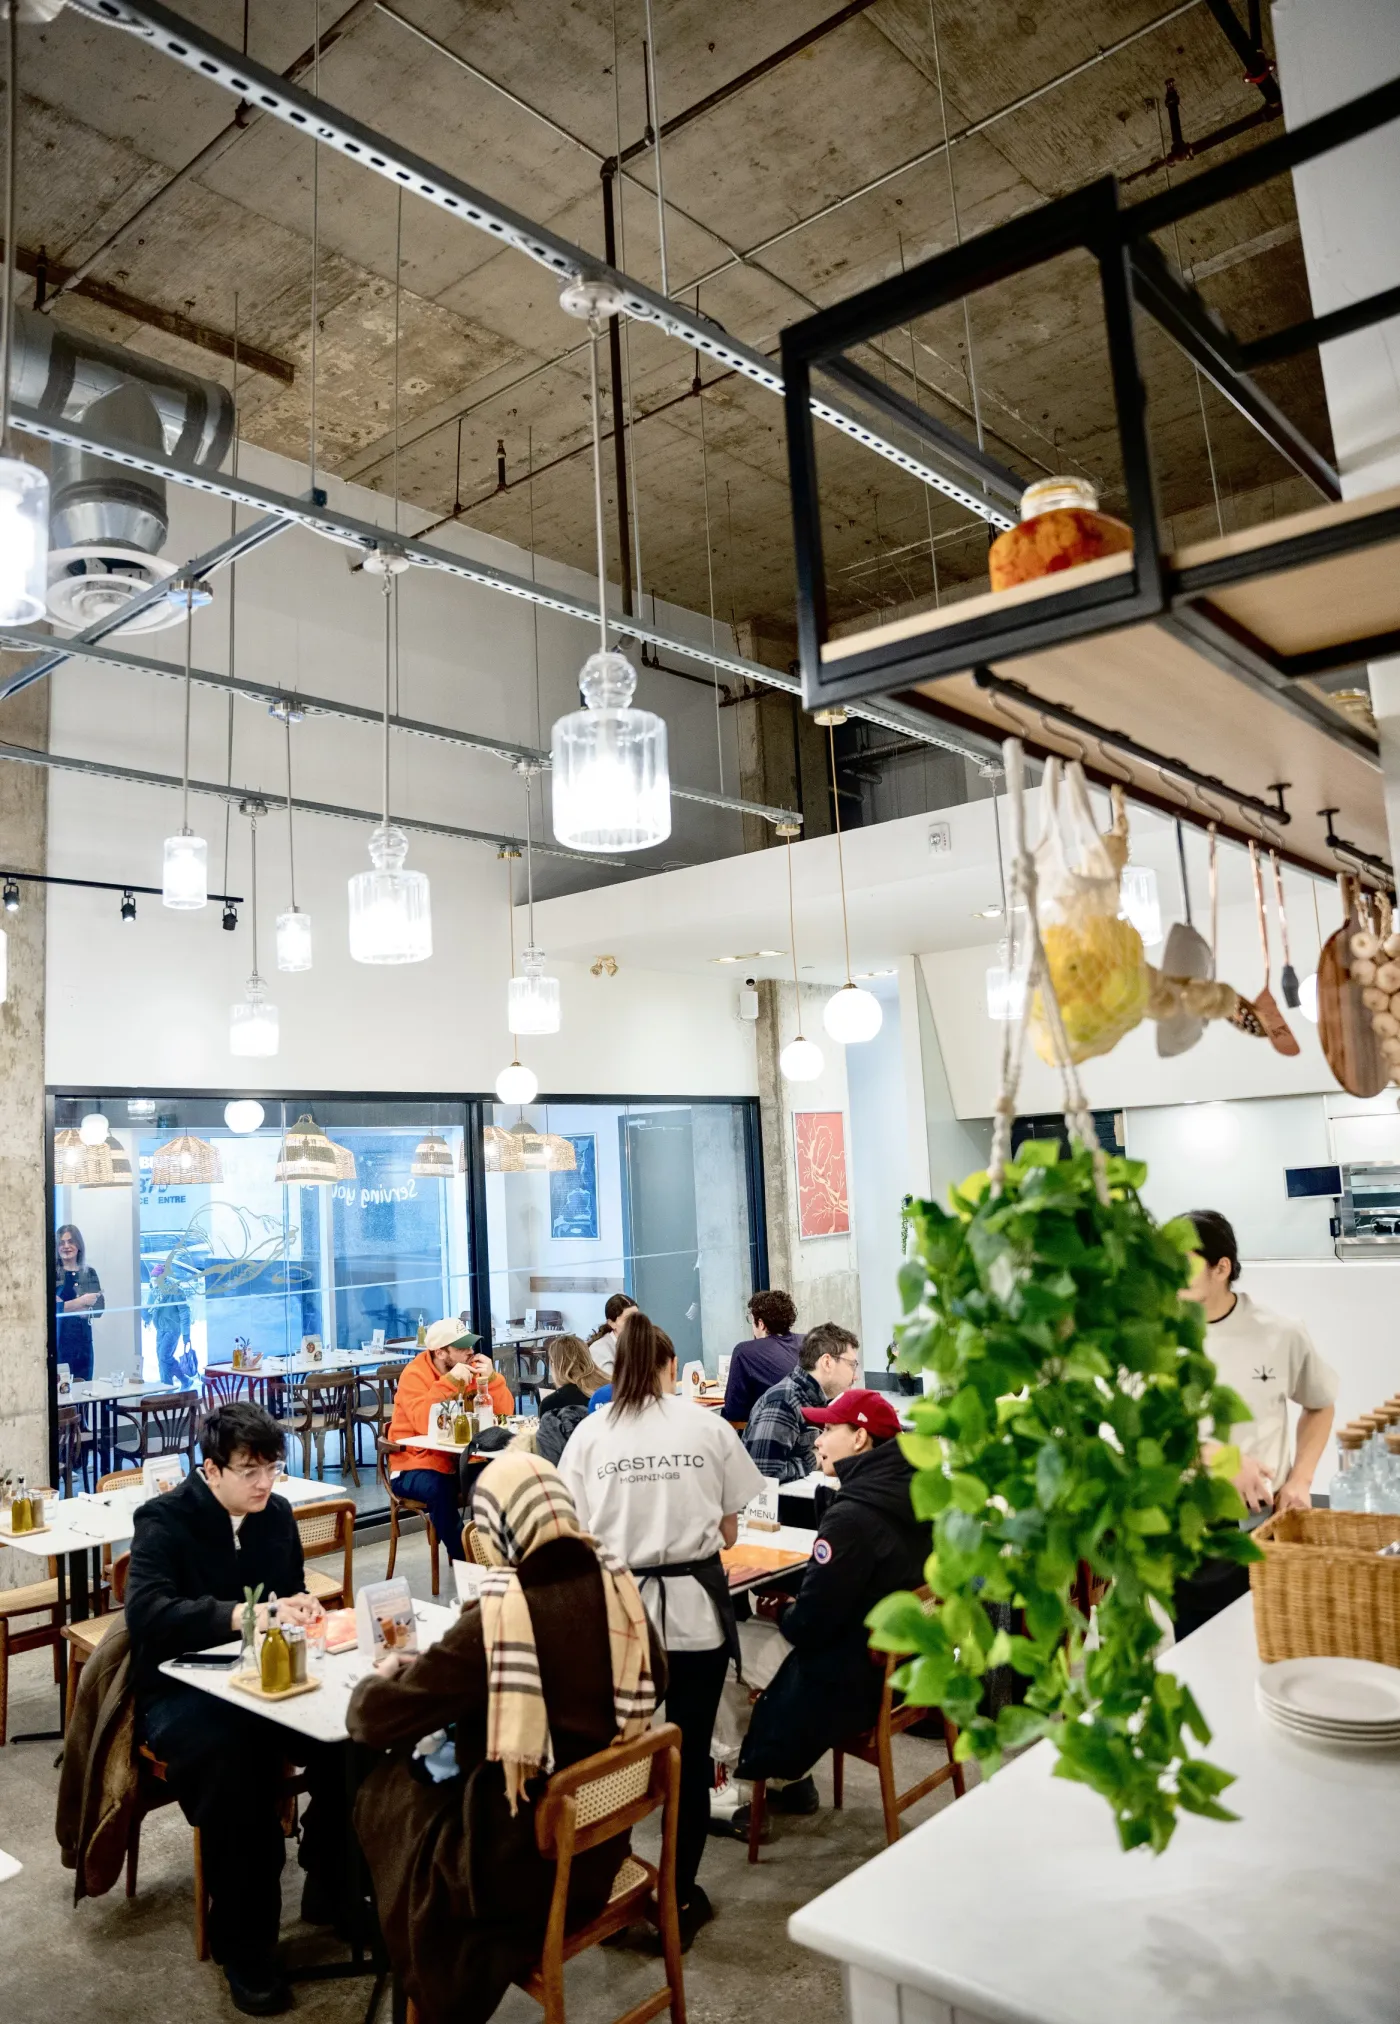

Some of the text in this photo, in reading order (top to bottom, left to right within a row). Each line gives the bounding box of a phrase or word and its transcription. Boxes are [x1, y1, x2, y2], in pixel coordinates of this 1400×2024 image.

[597, 1454, 705, 1480] EGGSTATIC
[620, 1471, 681, 1484] MORNINGS
[749, 1508, 776, 1521] MENU
